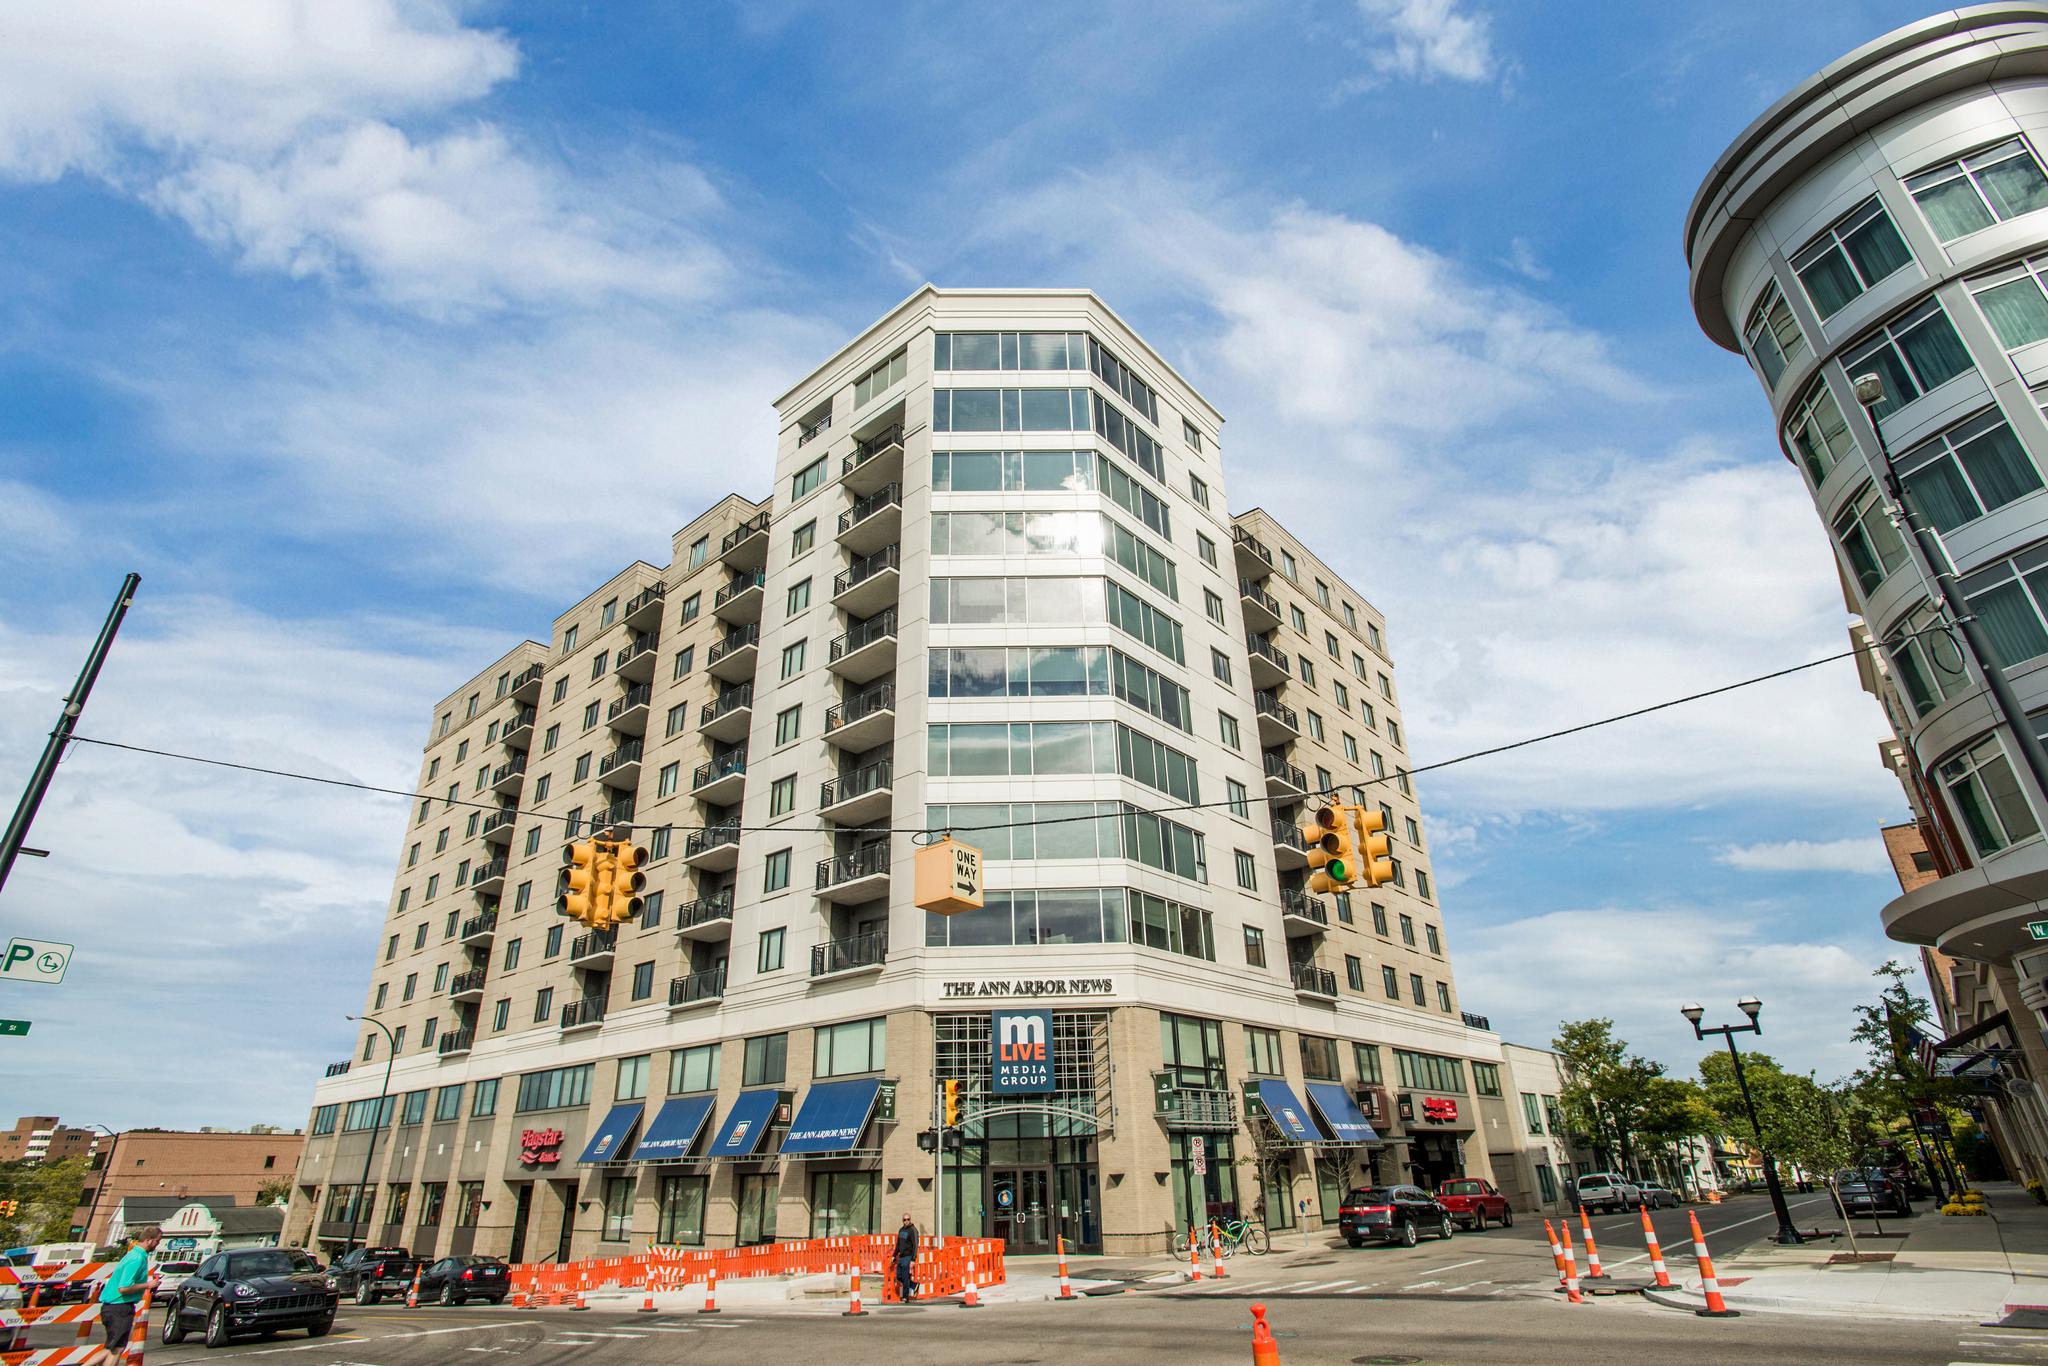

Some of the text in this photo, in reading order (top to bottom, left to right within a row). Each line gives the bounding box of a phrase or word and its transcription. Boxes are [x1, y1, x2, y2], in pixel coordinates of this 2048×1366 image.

[957, 850, 976, 867] ONE
[956, 863, 977, 880] WAY
[3, 944, 34, 972] P
[943, 978, 1113, 998] THE ANN ARBOR NEWS
[1000, 1043, 1046, 1062] LIVE
[1000, 1064, 1047, 1075] MEDIA
[1000, 1075, 1047, 1086] GROUP
[521, 1128, 561, 1150] Flagstar
[789, 1132, 803, 1140] THE
[802, 1130, 816, 1140] ANN
[815, 1129, 839, 1139] ARBOR
[838, 1127, 859, 1136] NEWS
